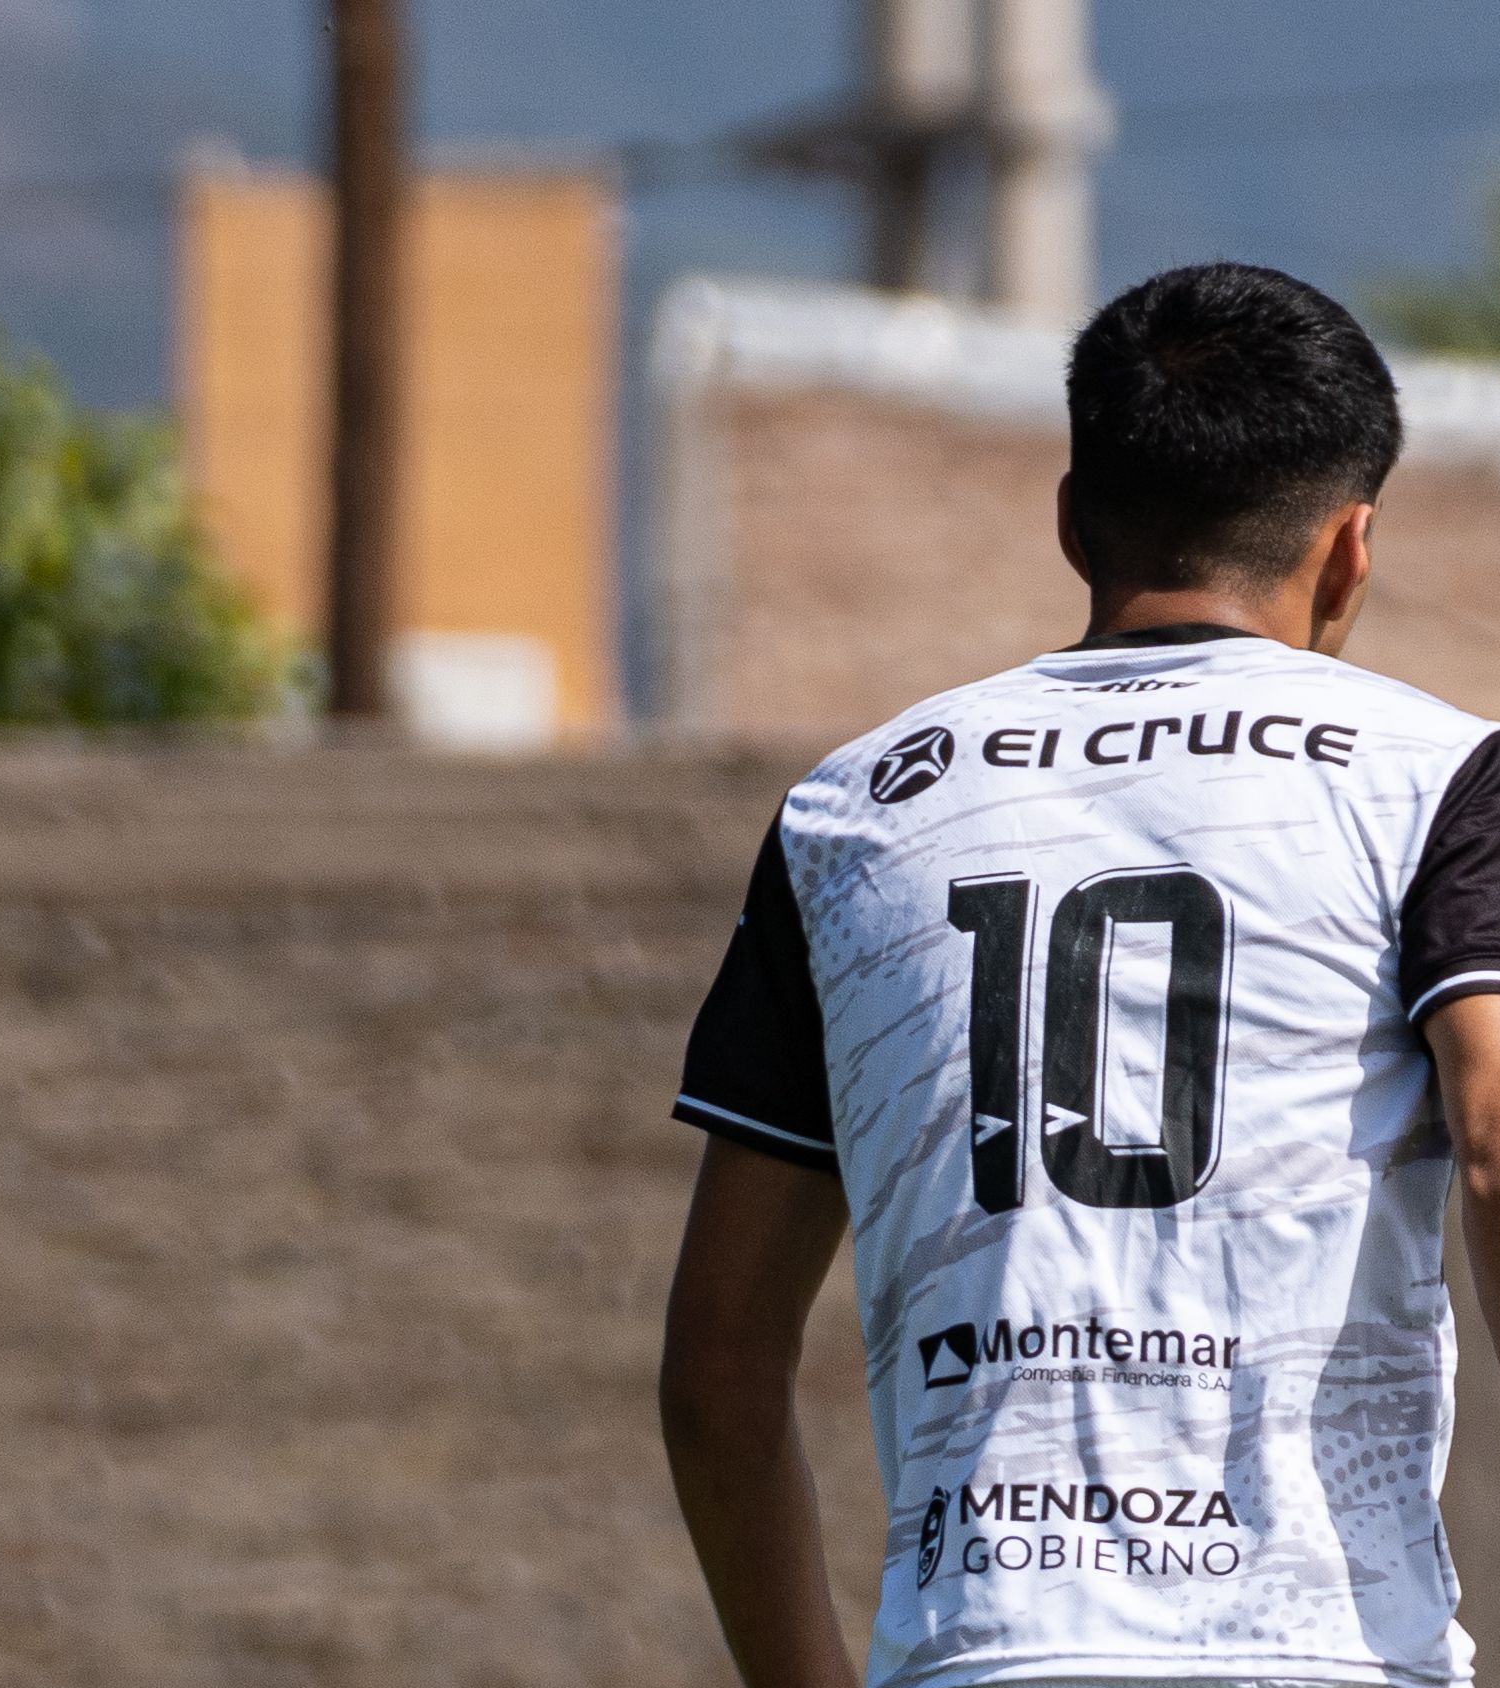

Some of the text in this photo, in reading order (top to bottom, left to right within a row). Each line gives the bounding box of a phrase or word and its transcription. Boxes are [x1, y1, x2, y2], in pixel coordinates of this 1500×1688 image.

[947, 862, 1235, 1216] 10
[974, 1316, 1241, 1370] Montemar
[1101, 1367, 1192, 1388] Financiera
[959, 1483, 1239, 1528] MENDOZA
[962, 1534, 1241, 1576] GOBIERNO
